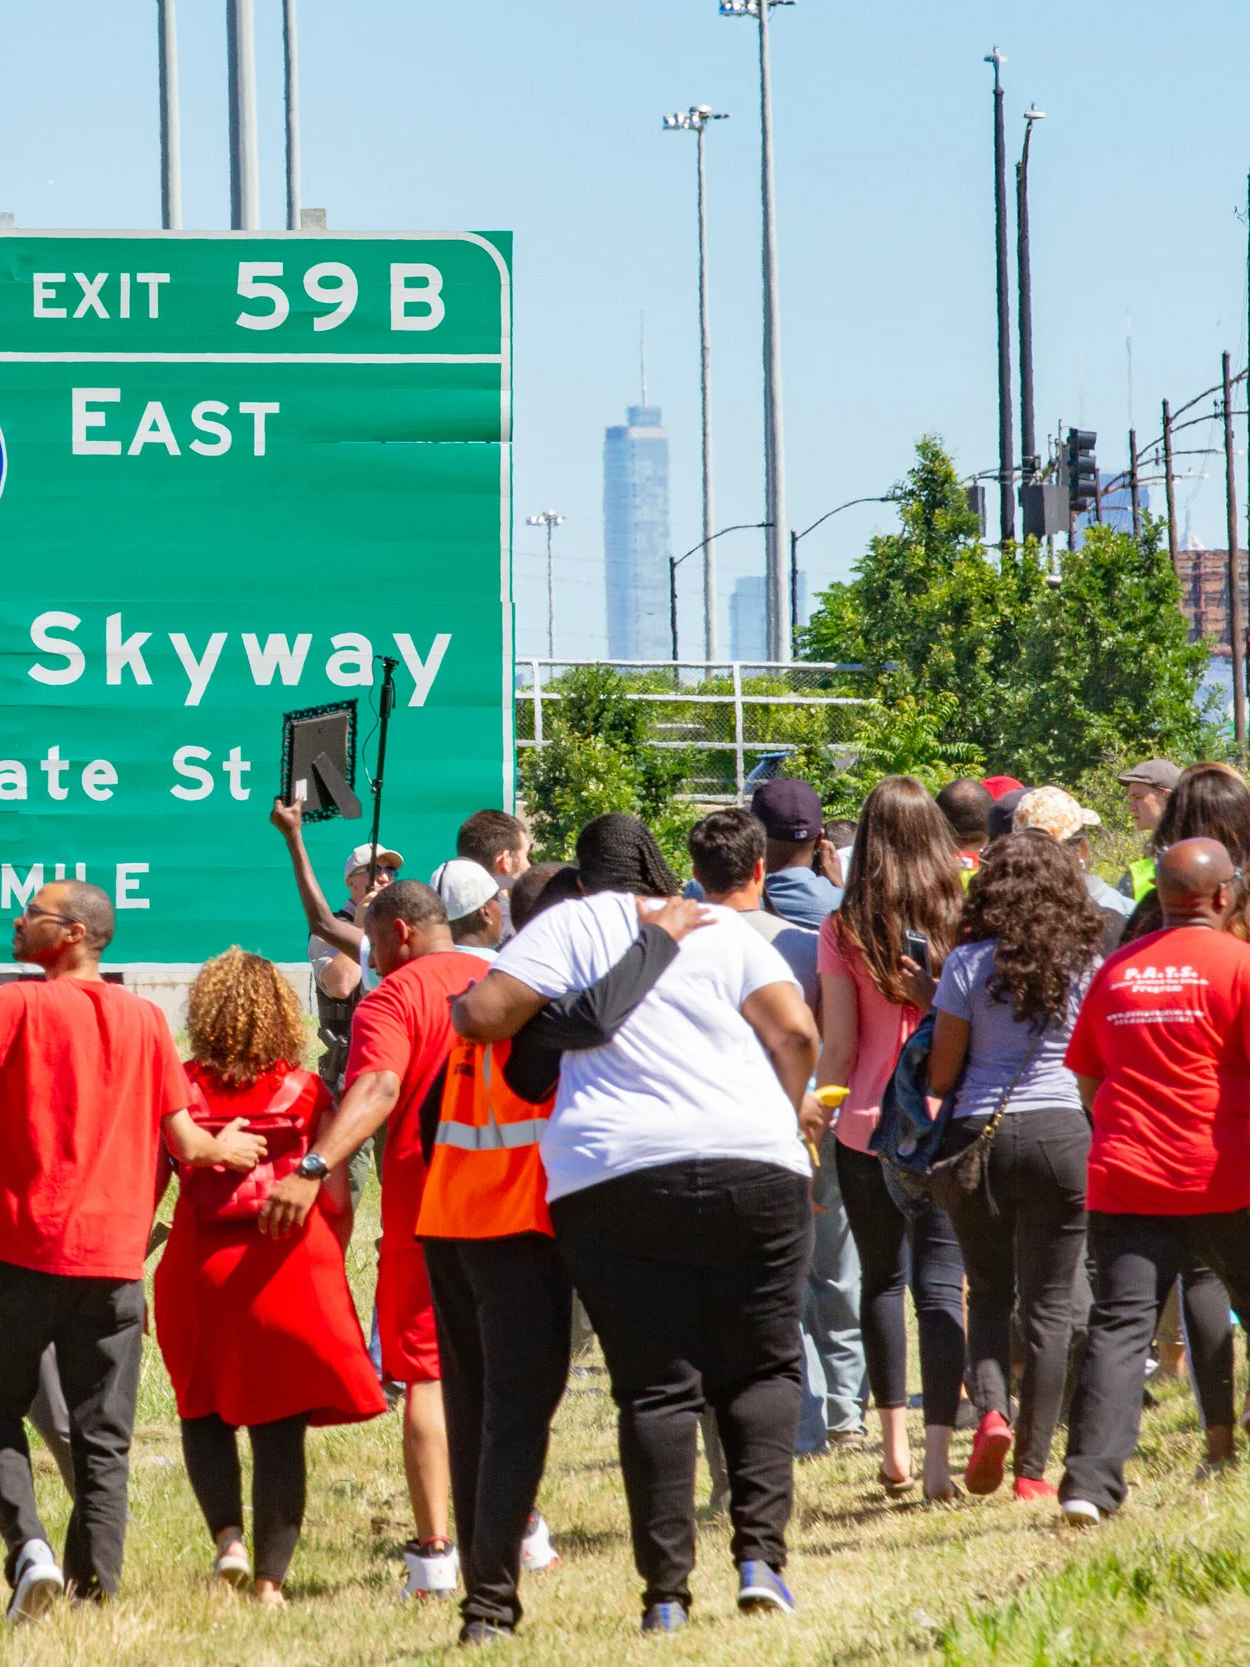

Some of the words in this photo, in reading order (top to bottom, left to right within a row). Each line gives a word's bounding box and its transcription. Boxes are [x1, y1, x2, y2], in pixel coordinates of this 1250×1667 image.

[33, 272, 170, 319] EXIT
[236, 262, 359, 332] 59
[390, 263, 445, 331] B
[71, 388, 280, 457] EAST
[28, 611, 452, 707] Skyway
[171, 745, 251, 801] St
